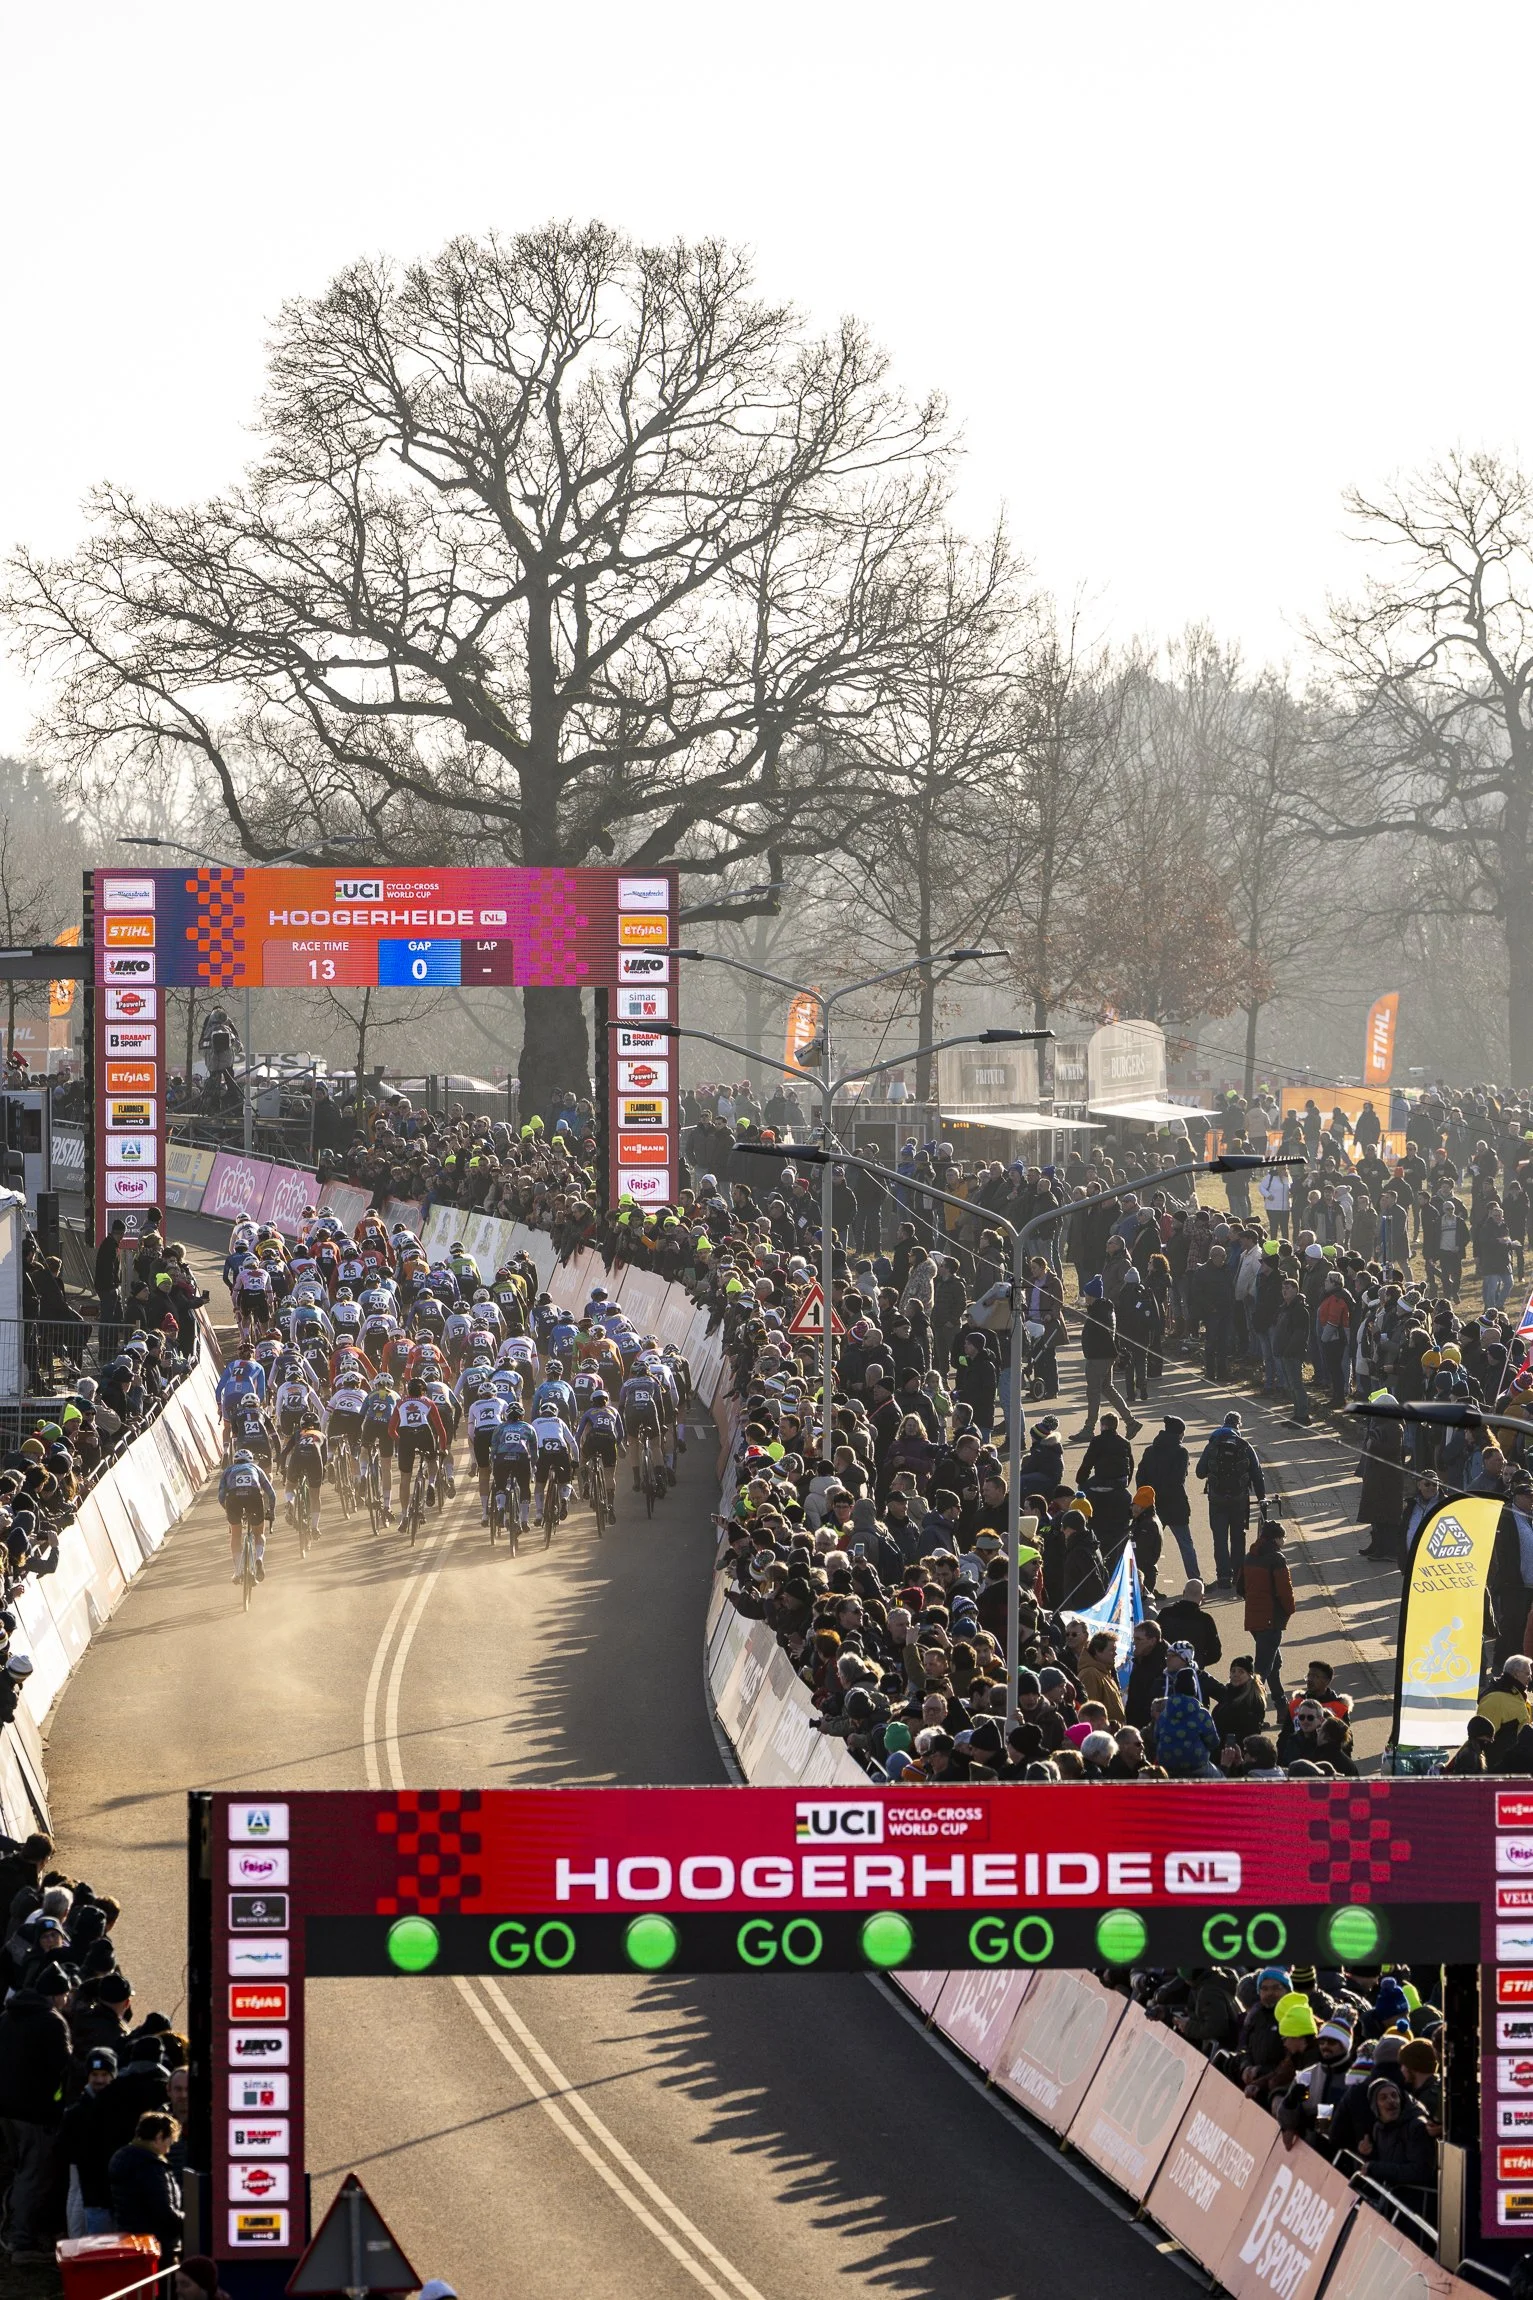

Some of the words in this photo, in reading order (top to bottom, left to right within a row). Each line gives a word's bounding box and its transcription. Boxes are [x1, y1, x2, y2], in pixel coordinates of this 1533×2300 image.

[343, 884, 380, 898] UCI
[269, 910, 474, 925] HOOGERHEIDE
[109, 926, 150, 936] STIHL
[293, 942, 321, 951] RACE
[323, 942, 349, 951] TIME
[408, 941, 432, 951] GAP
[477, 941, 498, 951] LAP
[309, 959, 336, 980] 13
[412, 959, 428, 980] 0
[630, 960, 664, 971] IKO
[629, 992, 656, 1001] simac
[110, 1035, 119, 1047] B
[622, 1034, 631, 1046] B
[1373, 1008, 1391, 1070] STIHL
[1111, 1054, 1145, 1078] BURGERS
[366, 1258, 376, 1266] 10
[344, 1269, 356, 1277] 45
[502, 1293, 511, 1301] 11
[425, 1307, 437, 1315] 55
[483, 1311, 494, 1319] 28
[542, 1311, 554, 1319] 20
[453, 1327, 464, 1336] 57
[562, 1338, 574, 1347] 38
[622, 1340, 635, 1348] 54
[260, 1350, 273, 1359] 32
[513, 1350, 526, 1358] 48
[601, 1351, 612, 1359] 14
[233, 1367, 244, 1375] 71
[469, 1374, 480, 1383] 53
[497, 1384, 508, 1392] 23
[288, 1394, 300, 1404] 77
[432, 1394, 445, 1402] 76
[636, 1392, 649, 1400] 33
[372, 1402, 387, 1411] 79
[407, 1412, 420, 1421] 47
[480, 1410, 494, 1418] 64
[597, 1417, 610, 1425] 58
[245, 1422, 259, 1432] 24
[300, 1437, 314, 1445] 42
[506, 1433, 520, 1442] 65
[544, 1441, 559, 1451] 62
[236, 1476, 251, 1484] 63
[1444, 1518, 1470, 1544] WEST
[1428, 1522, 1446, 1555] ZUID
[1438, 1545, 1471, 1557] HOEK
[1418, 1561, 1478, 1578] WIELER
[1412, 1576, 1479, 1594] COLLEGE
[888, 1808, 982, 1821] CYCLO-CROSS
[811, 1810, 875, 1835] UCI
[889, 1822, 938, 1836] WORLD
[941, 1822, 968, 1836] CUP
[556, 1852, 1152, 1900] HOOGERHEIDE
[1177, 1862, 1229, 1883] NL
[489, 1921, 576, 1969] GO
[737, 1918, 823, 1966] GO
[968, 1916, 1055, 1963] GO
[1202, 1913, 1287, 1960] GO
[243, 2079, 275, 2089] simac
[235, 2130, 245, 2145] B
[1186, 2110, 1229, 2166] BRABANT
[1217, 2134, 1256, 2191] STERKER
[1169, 2148, 1202, 2194] DOOR
[1187, 2163, 1222, 2213] SPORT
[1256, 2230, 1311, 2300] SPORT
